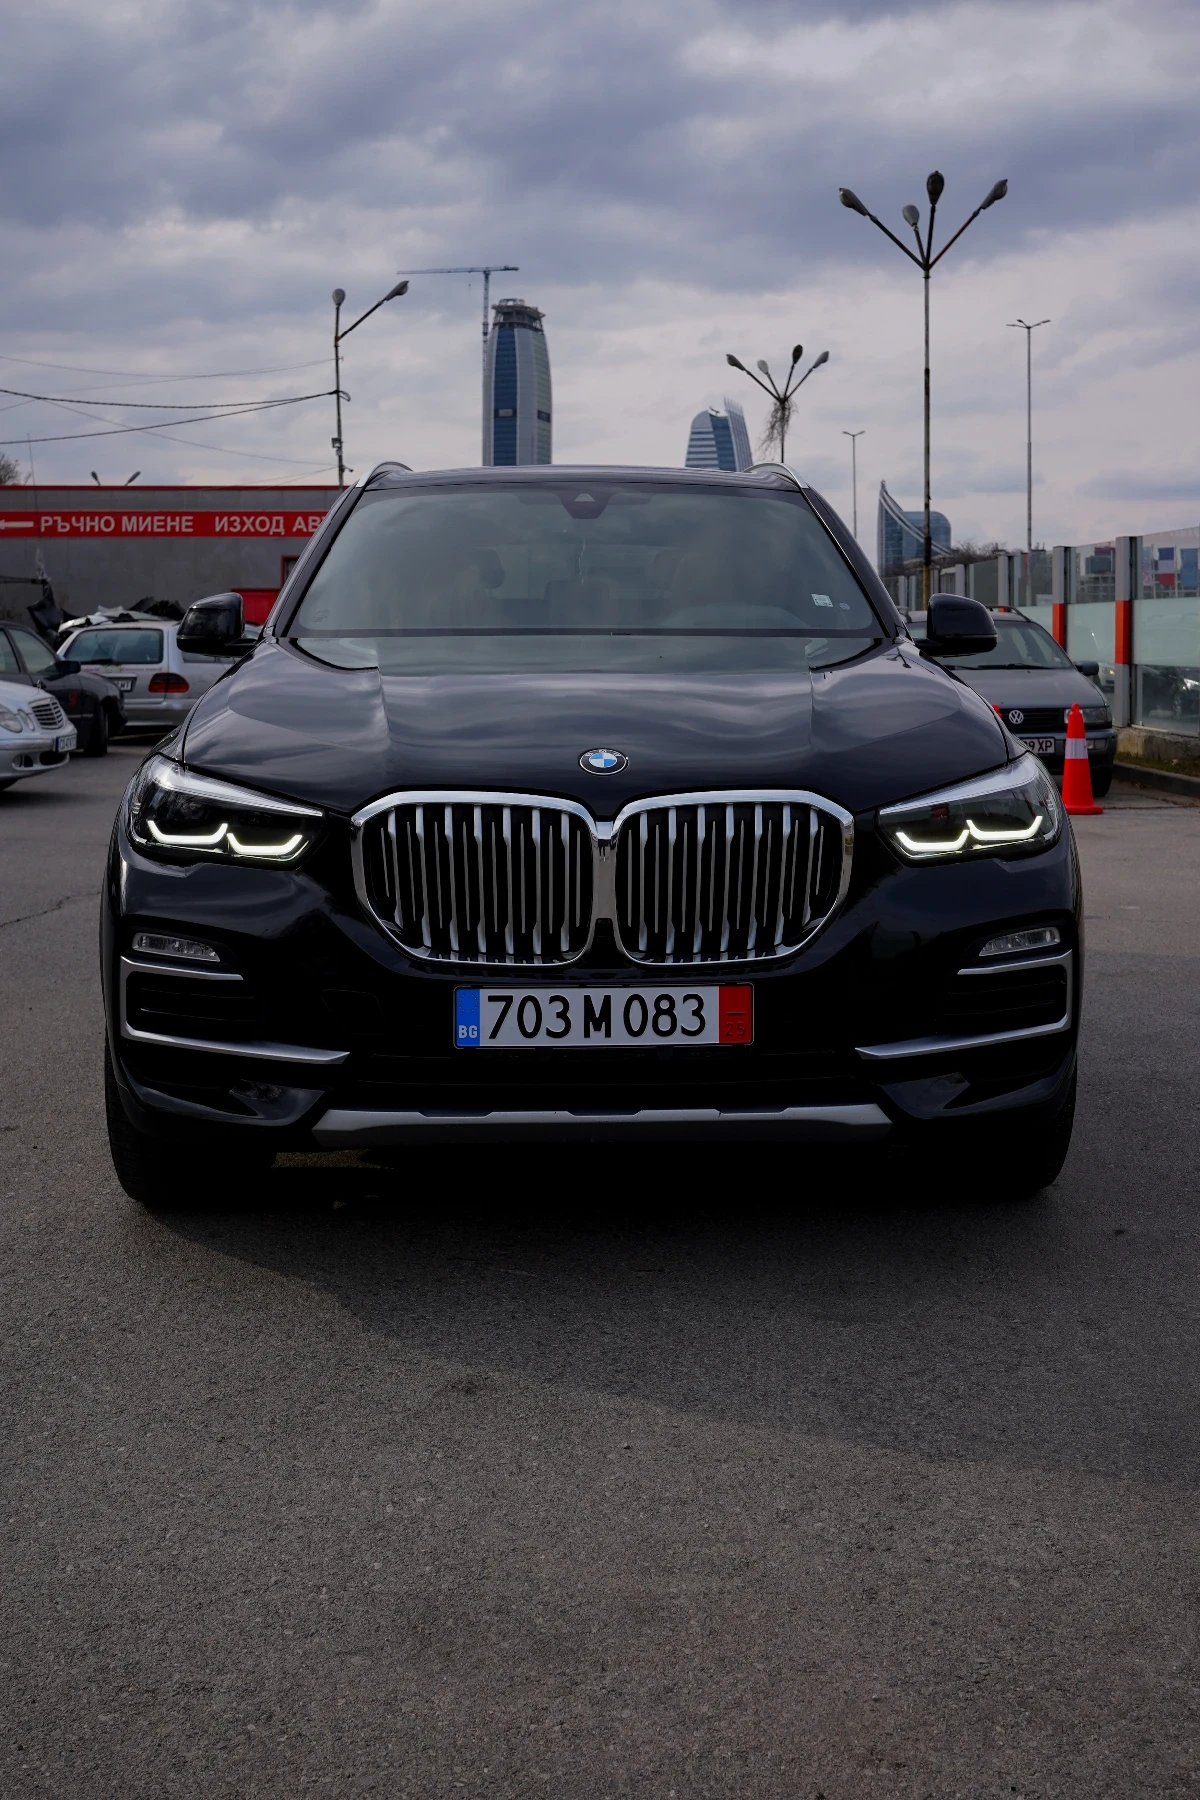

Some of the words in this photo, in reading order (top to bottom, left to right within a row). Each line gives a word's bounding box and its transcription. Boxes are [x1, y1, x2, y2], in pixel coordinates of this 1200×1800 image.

[40, 516, 115, 533] РЪЧНО
[121, 516, 194, 533] МИЕНЕ
[215, 516, 285, 535] ИЗХОД
[292, 516, 326, 532] АВ
[1037, 740, 1053, 751] XP
[487, 994, 572, 1039] 703
[583, 994, 612, 1038] M
[623, 993, 706, 1037] 083
[458, 1025, 478, 1038] BG
[725, 1022, 745, 1037] 25
